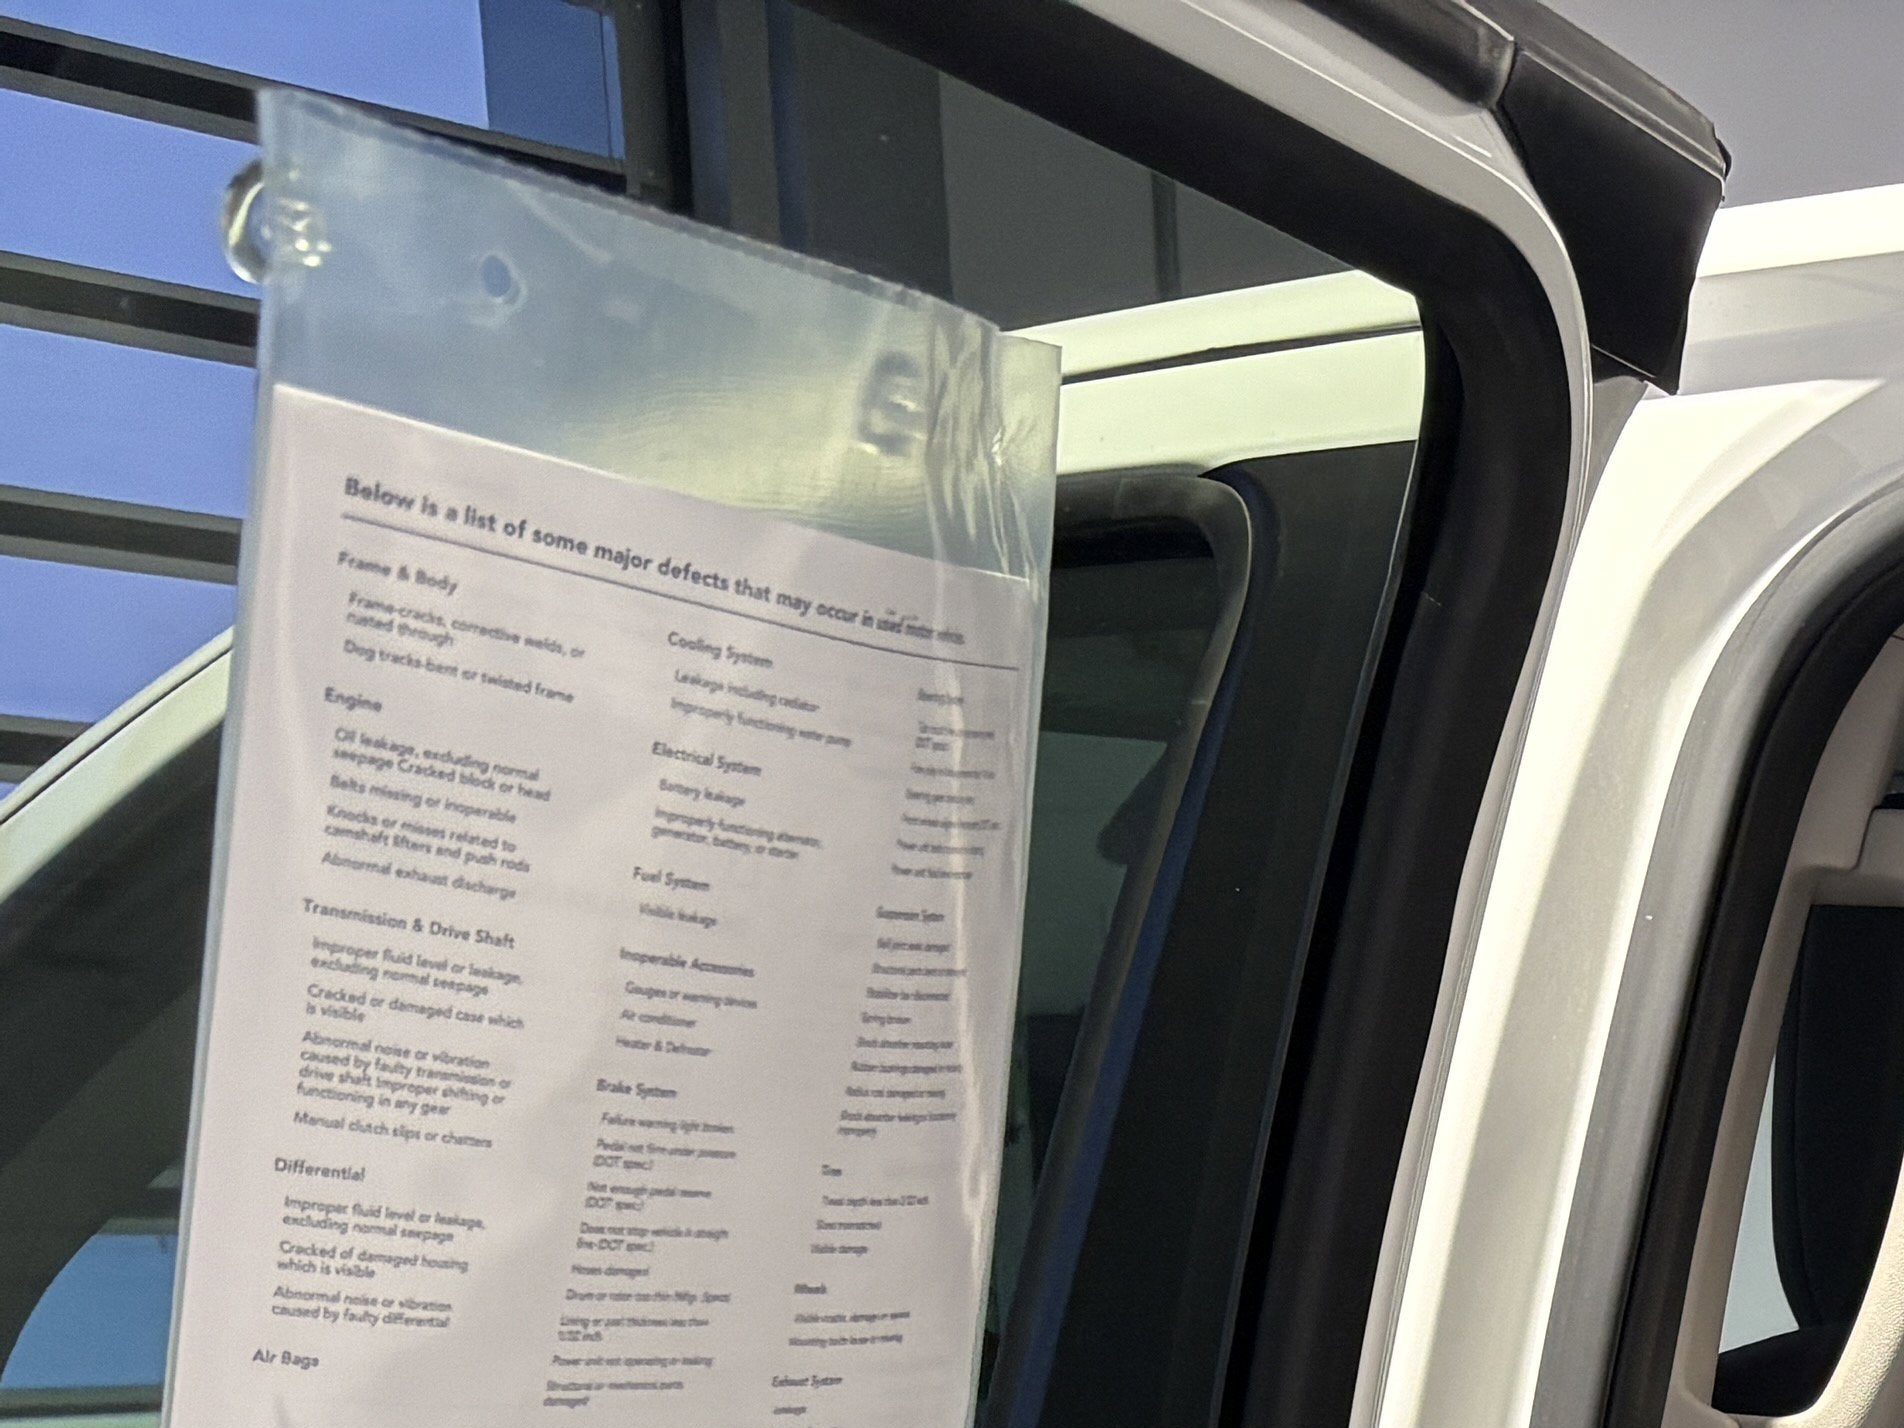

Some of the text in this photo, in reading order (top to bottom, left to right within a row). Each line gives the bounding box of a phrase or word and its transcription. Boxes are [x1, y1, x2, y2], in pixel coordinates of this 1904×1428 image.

[345, 477, 414, 511] Below
[421, 496, 438, 517] is
[445, 507, 458, 522] a
[463, 505, 497, 533] list
[503, 519, 527, 538] of
[532, 528, 588, 555] some
[593, 544, 653, 572] major
[658, 557, 729, 591] defects
[735, 578, 770, 602] that
[777, 591, 813, 617] may
[816, 603, 859, 624] occur
[338, 551, 391, 577] Frame
[415, 569, 457, 596] Body
[481, 672, 532, 695] twisted
[535, 683, 574, 703] frame
[324, 687, 382, 712] Engine
[335, 727, 355, 743] Oil
[633, 866, 663, 883] Fuel
[303, 898, 515, 949] Transmission & Drive Shaft
[382, 948, 413, 966] fluid
[416, 955, 448, 972] level
[306, 1003, 366, 1023] is visible
[307, 984, 367, 1005] Cracked
[389, 999, 452, 1020] damaged
[455, 1010, 486, 1023] case
[488, 1014, 525, 1029] which
[302, 1030, 372, 1053] Abnormal
[375, 1043, 411, 1058] noise
[300, 1050, 350, 1067] caused
[354, 1055, 371, 1073] by
[596, 1078, 632, 1095] Brake
[293, 1111, 345, 1129] Manual
[274, 1157, 365, 1182] Differential
[279, 1240, 337, 1259] Cracked
[277, 1259, 375, 1279] which is visible
[273, 1286, 342, 1303] Abnormal
[272, 1304, 321, 1318] caused
[323, 1307, 340, 1323] by
[252, 1349, 319, 1371] Air Bags
